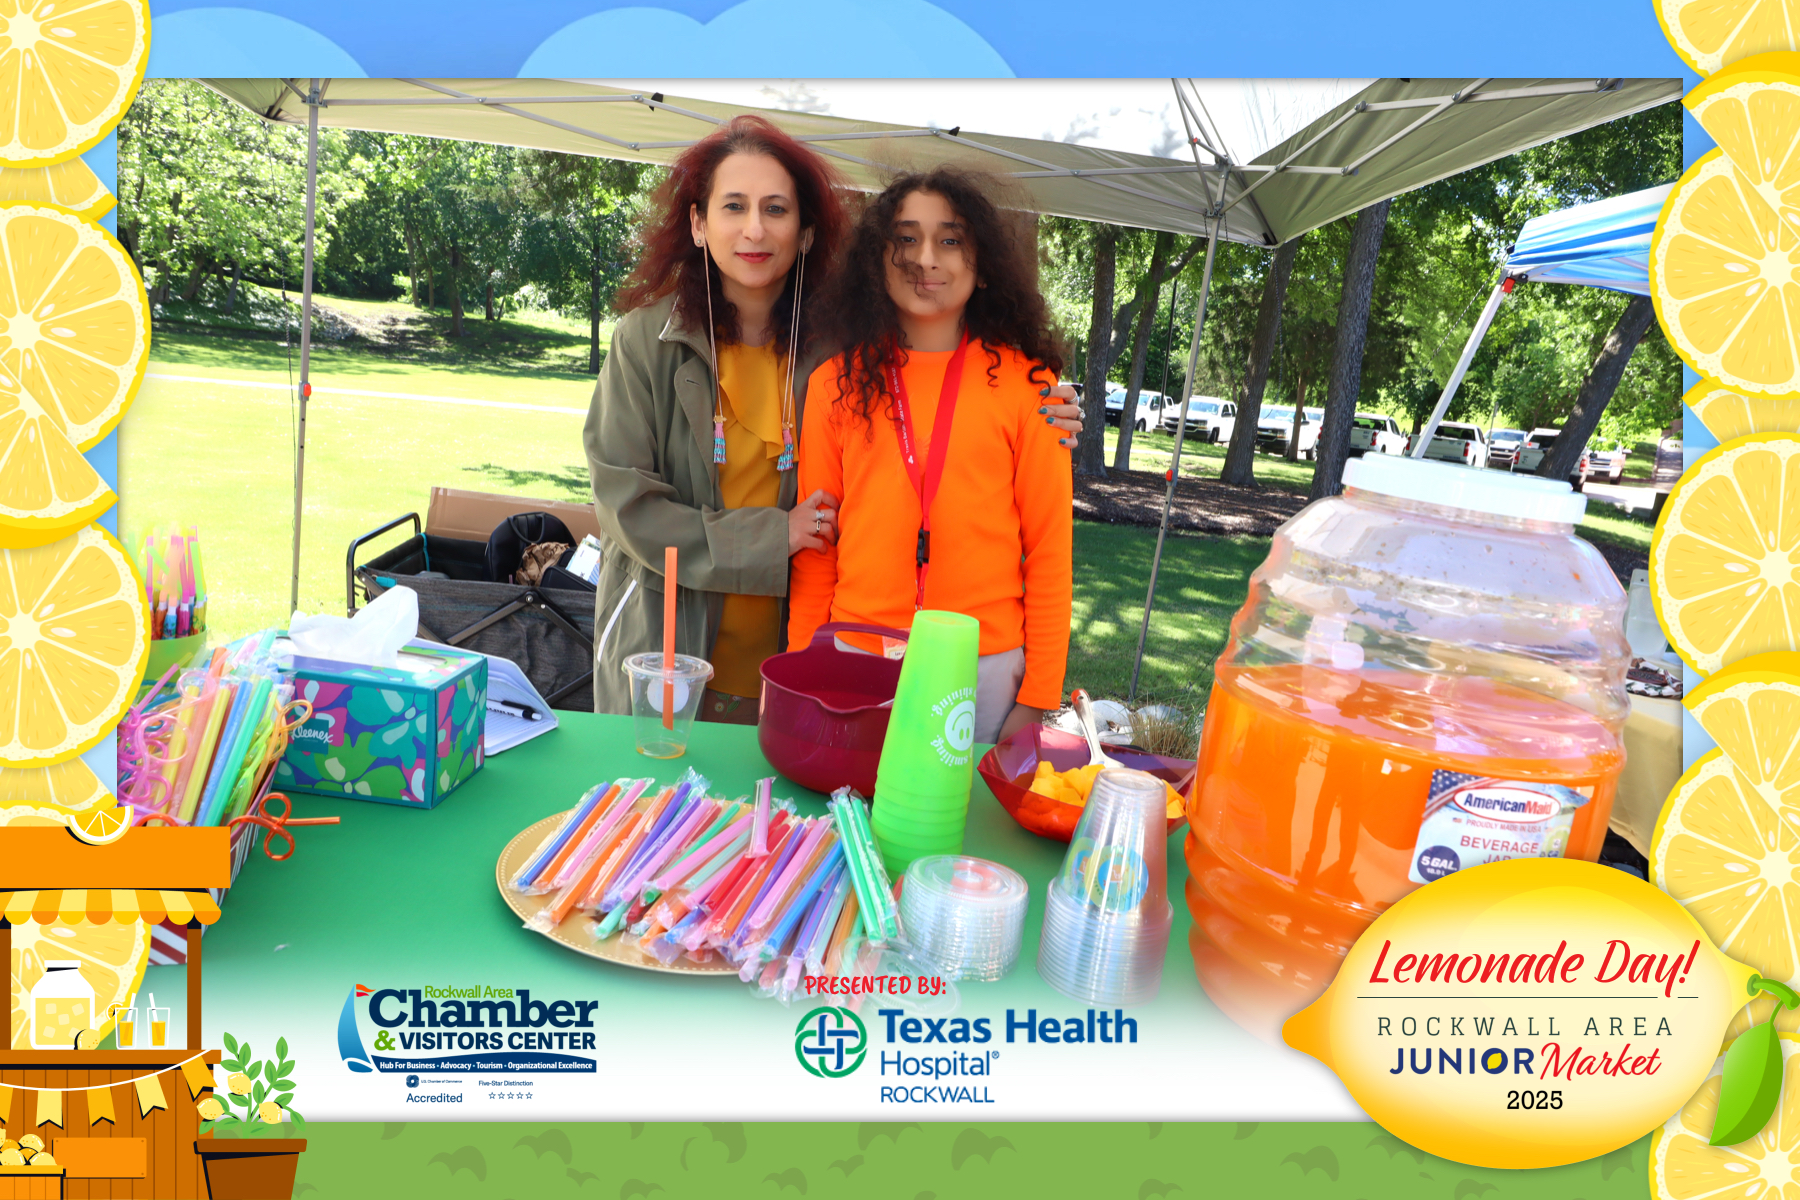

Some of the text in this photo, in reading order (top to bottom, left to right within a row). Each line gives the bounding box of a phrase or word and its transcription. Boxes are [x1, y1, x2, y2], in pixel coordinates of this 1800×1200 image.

[1464, 793, 1552, 815] AmericanMaid
[1466, 819, 1499, 829] PROUDLY
[1500, 823, 1519, 832] MADE
[1460, 835, 1539, 854] BEVERAGE
